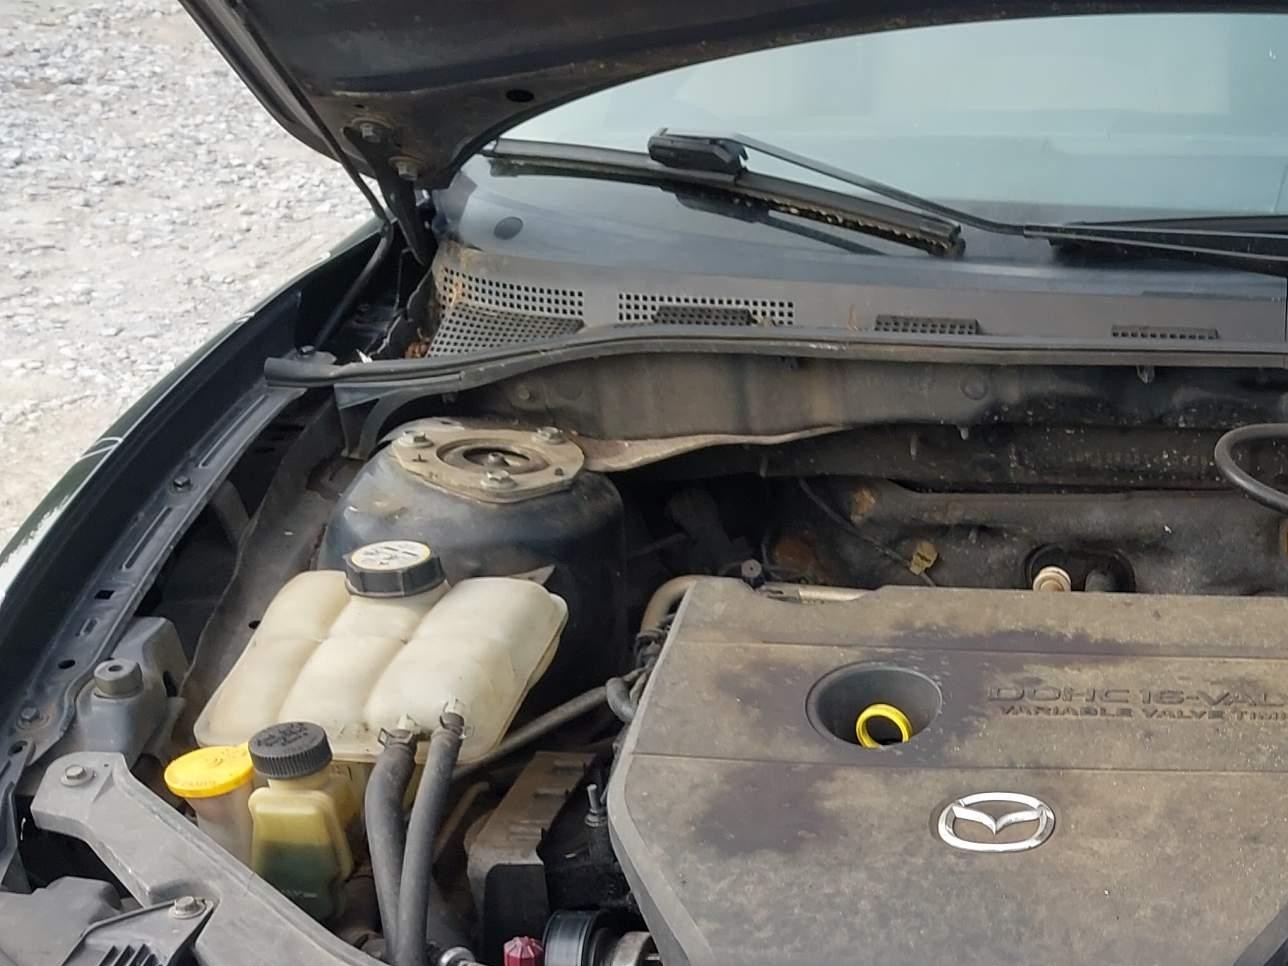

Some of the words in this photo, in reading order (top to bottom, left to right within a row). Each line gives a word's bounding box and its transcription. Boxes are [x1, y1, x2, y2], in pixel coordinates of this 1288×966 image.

[988, 686, 1130, 704] DOHC
[1000, 704, 1133, 718] VARIABLE
[1142, 708, 1225, 720] VALVE
